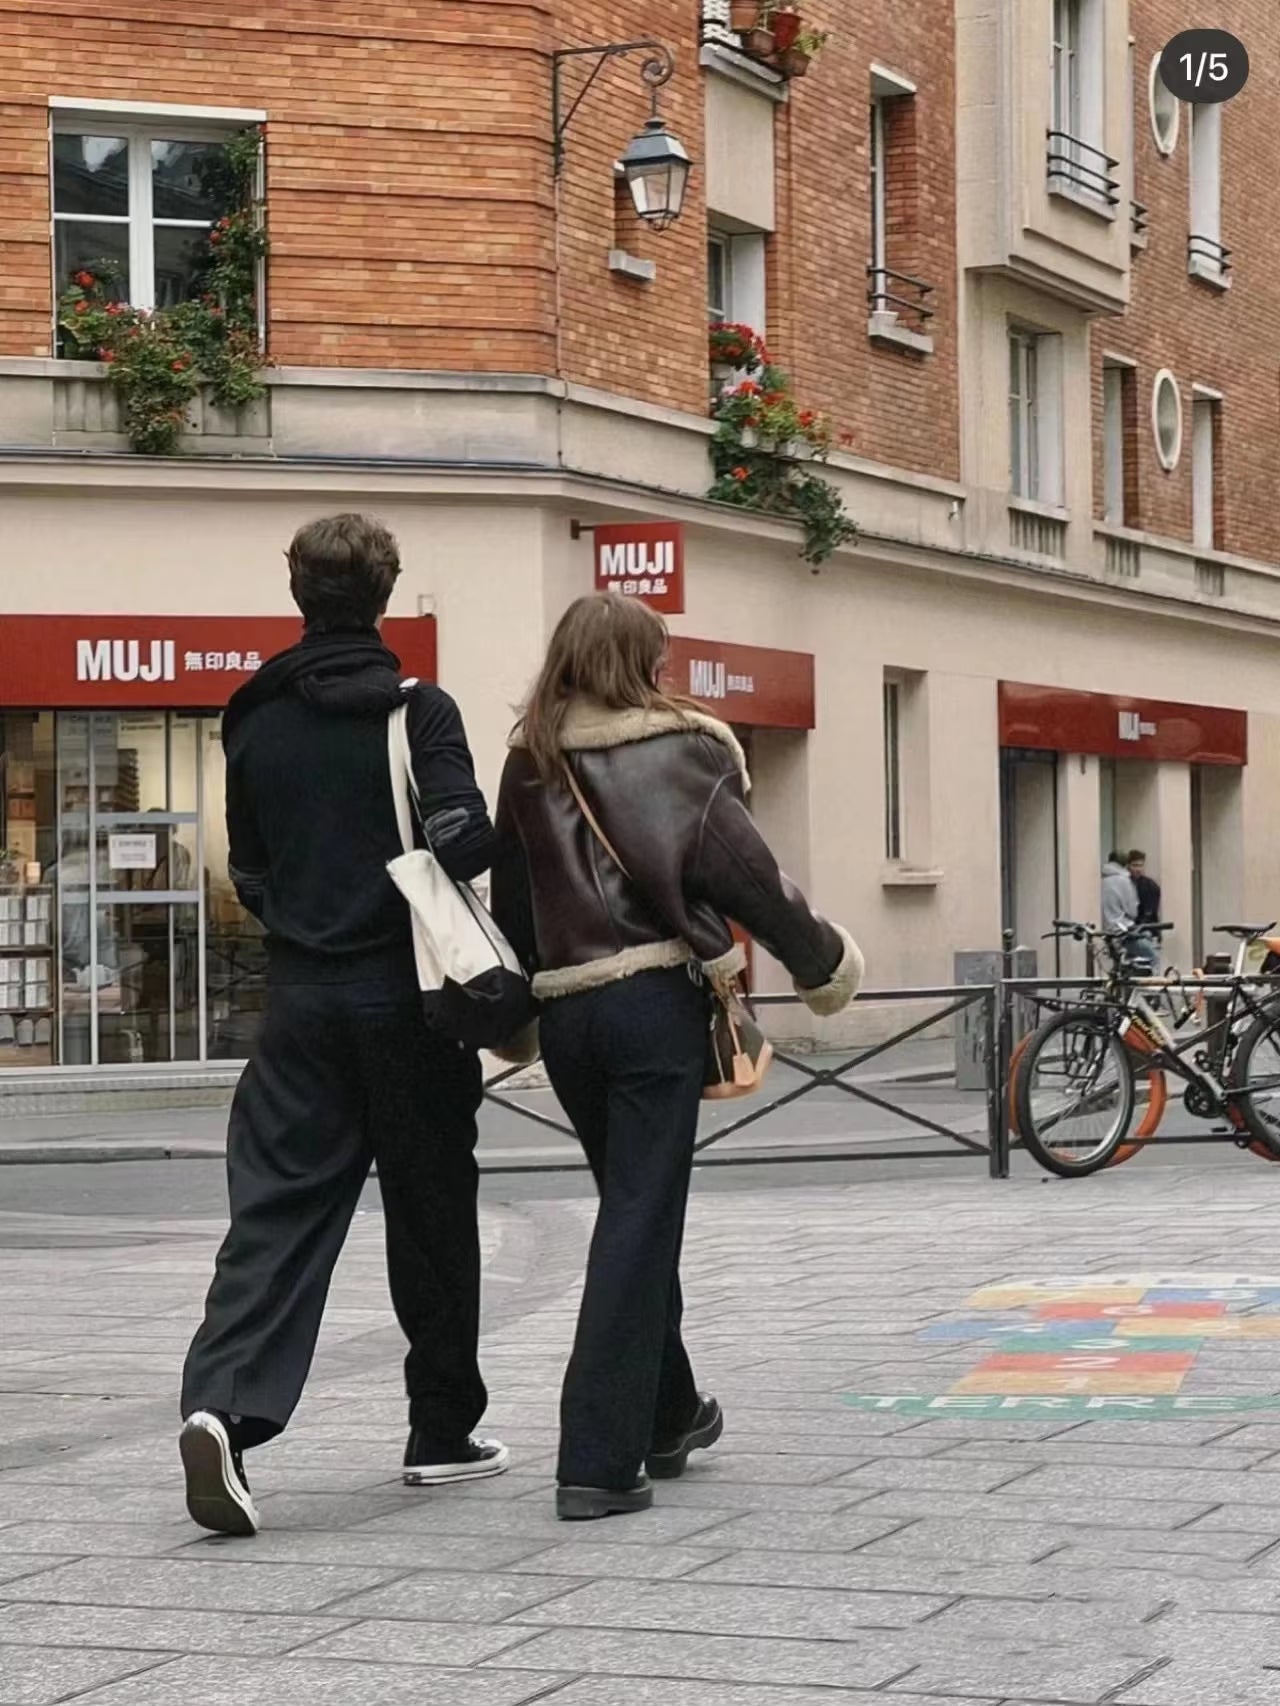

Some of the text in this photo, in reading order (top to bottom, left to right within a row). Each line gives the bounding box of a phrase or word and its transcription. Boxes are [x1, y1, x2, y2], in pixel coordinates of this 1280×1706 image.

[600, 541, 674, 576] MUJI
[77, 639, 262, 681] MUJI 無印良品
[690, 659, 725, 698] MUJI
[1071, 1338, 1129, 1349] 3
[1054, 1356, 1121, 1369] 2
[858, 1395, 1239, 1410] TERRE
